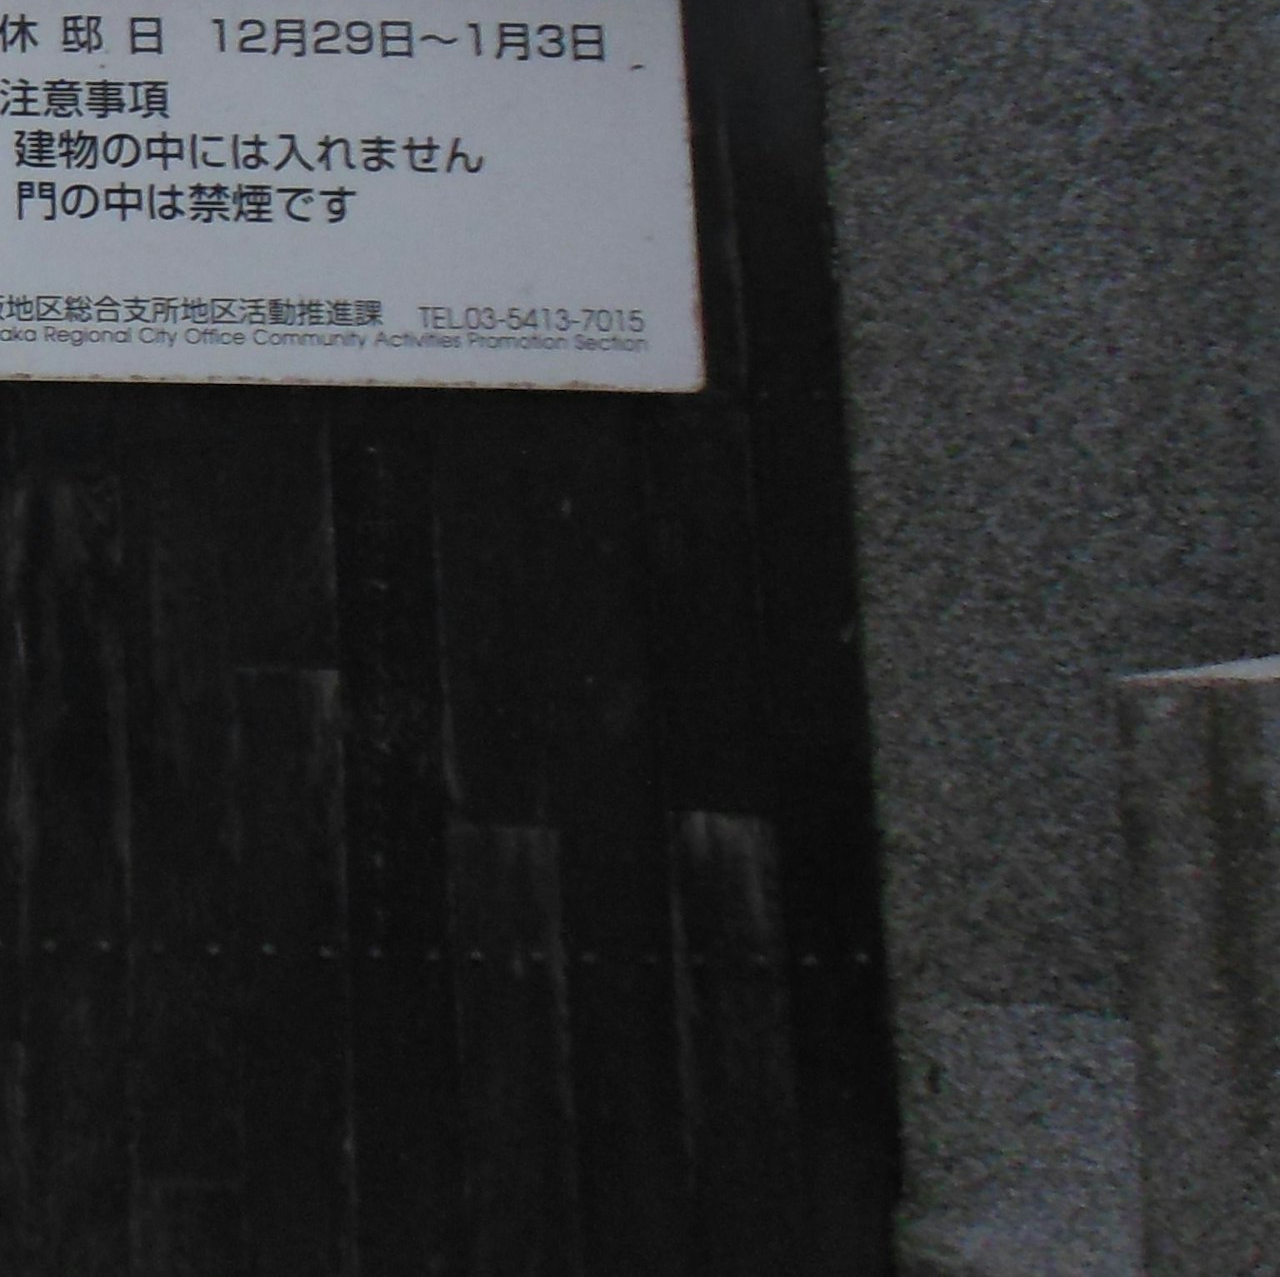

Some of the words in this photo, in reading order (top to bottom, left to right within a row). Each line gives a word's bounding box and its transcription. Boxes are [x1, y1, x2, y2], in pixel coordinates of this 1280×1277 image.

[13, 130, 485, 175] 建物の中には入れません
[16, 181, 358, 224] 門の中は禁煙です
[44, 326, 133, 347] Regional
[138, 327, 178, 348] City
[184, 328, 246, 345] Office
[252, 329, 367, 351] Community
[373, 331, 462, 349] Activities
[468, 333, 569, 350] Promotion
[574, 334, 649, 352] Section
